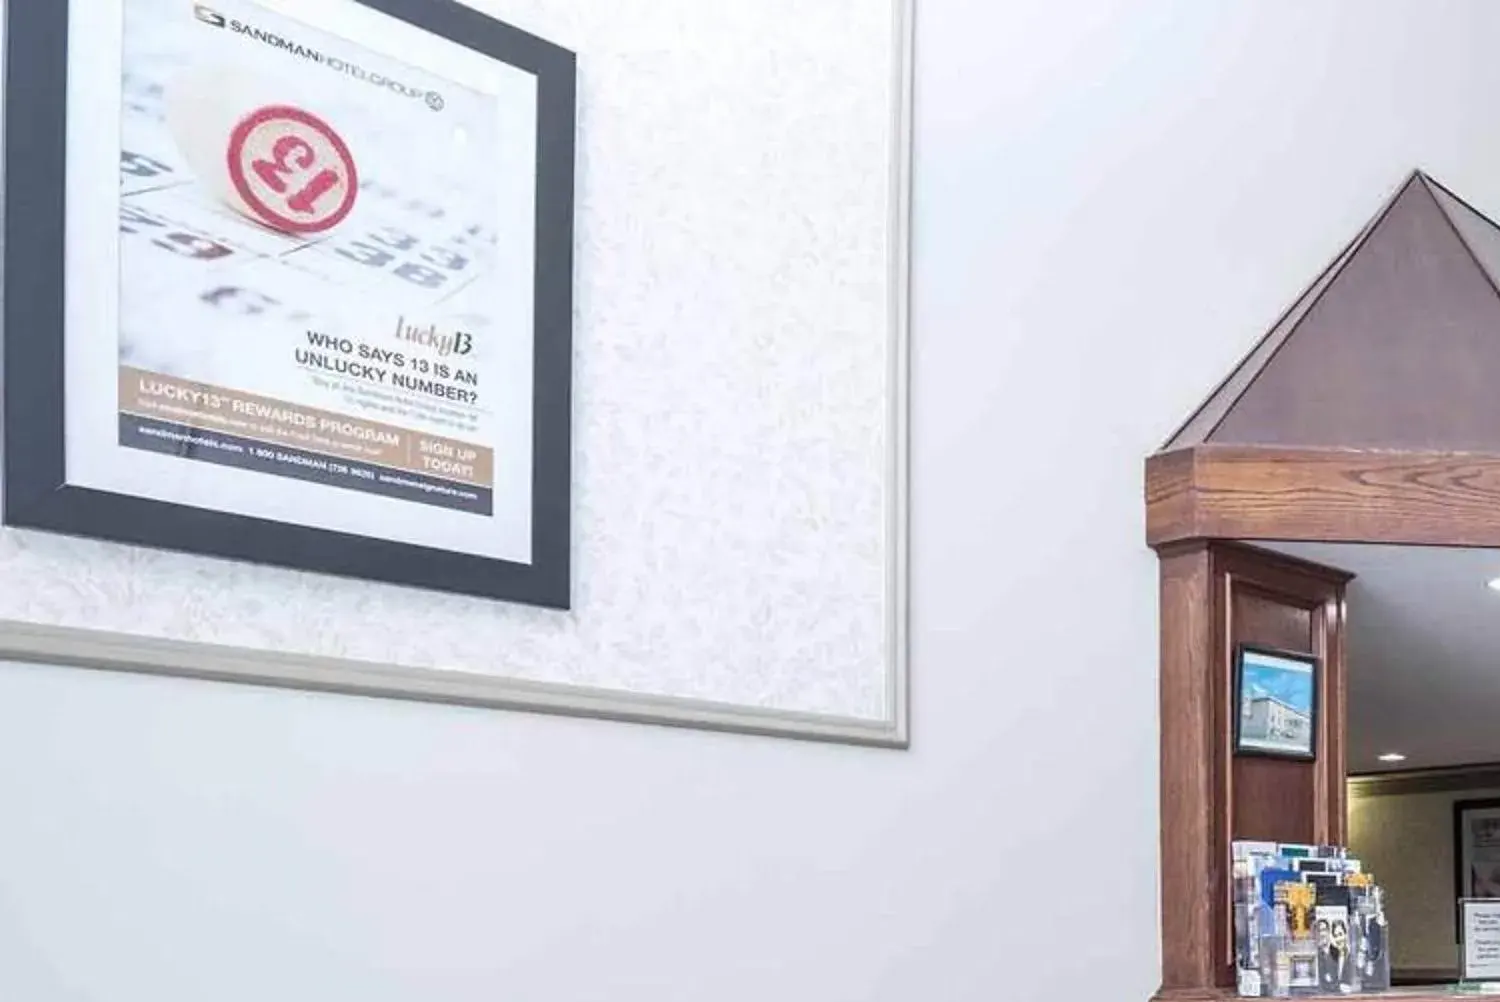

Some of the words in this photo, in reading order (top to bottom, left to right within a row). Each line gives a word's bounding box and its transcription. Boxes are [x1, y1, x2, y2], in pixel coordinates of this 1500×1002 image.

[295, 348, 387, 383] UNLUCKY
[391, 371, 479, 405] NUMBER?
[306, 330, 353, 354] WHO
[357, 342, 405, 368] SAYS
[410, 357, 429, 373] 13
[433, 363, 450, 379] IS
[454, 369, 478, 386] AN
[232, 399, 317, 429] REWARDS
[319, 419, 400, 447] PROGRAM
[419, 439, 454, 457] SIGN
[457, 447, 477, 461] UP
